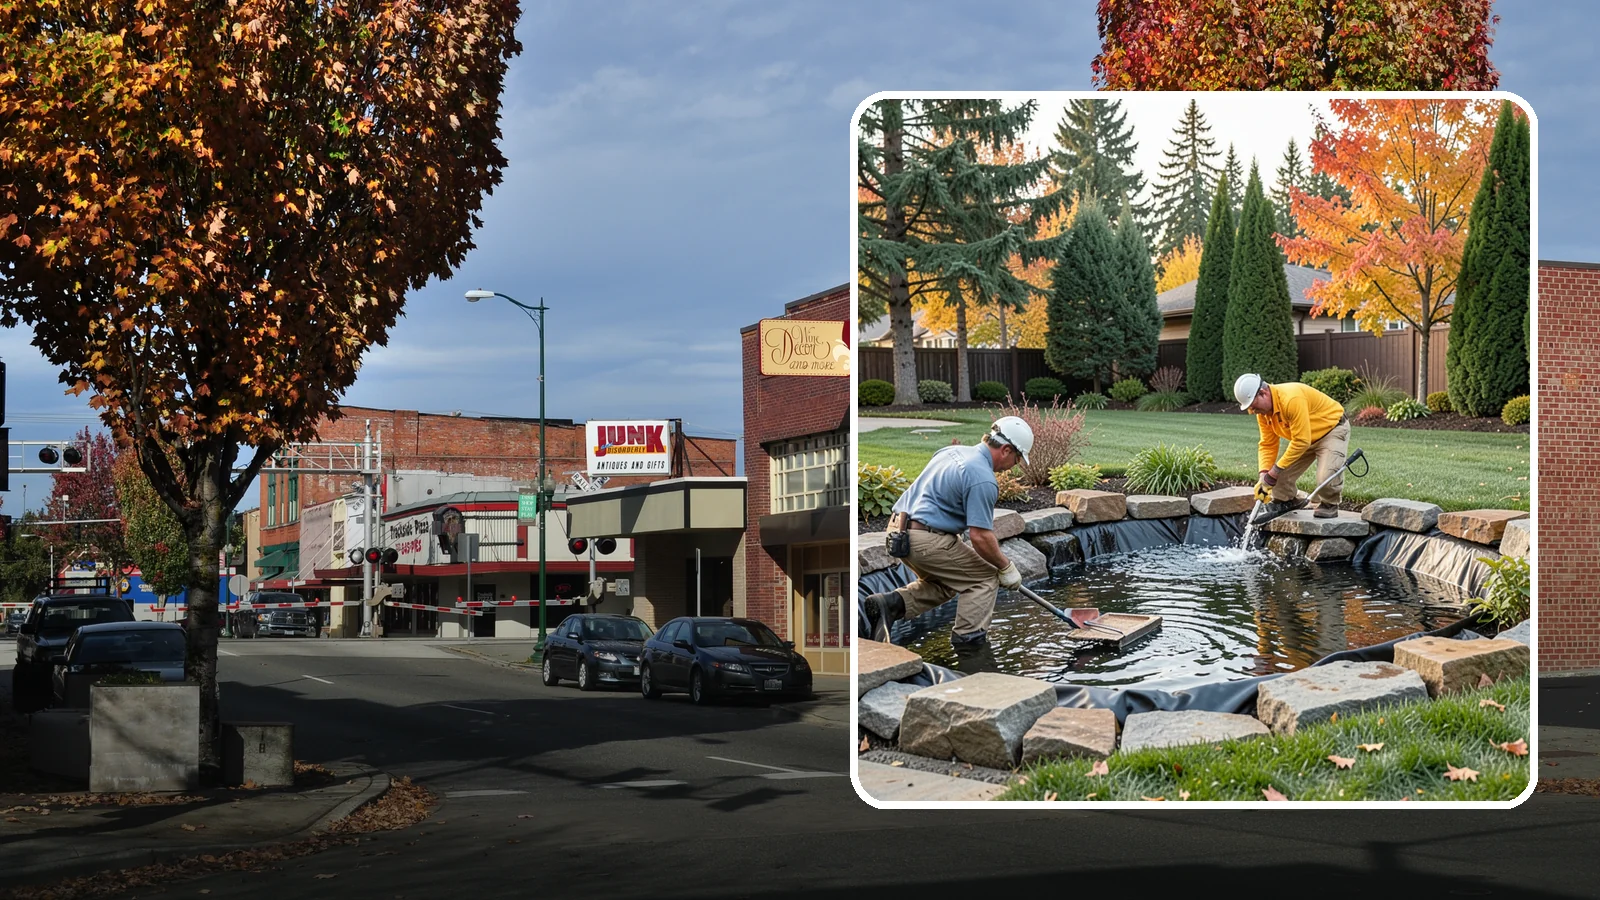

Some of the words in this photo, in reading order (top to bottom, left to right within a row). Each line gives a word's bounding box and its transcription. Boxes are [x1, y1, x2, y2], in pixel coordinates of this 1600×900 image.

[595, 425, 665, 457] JUNK
[607, 446, 646, 454] DISORDERLY
[597, 461, 628, 470] ANTIQUES
[631, 461, 644, 470] AND
[647, 460, 665, 469] GIFTS
[414, 519, 429, 535] Pizza
